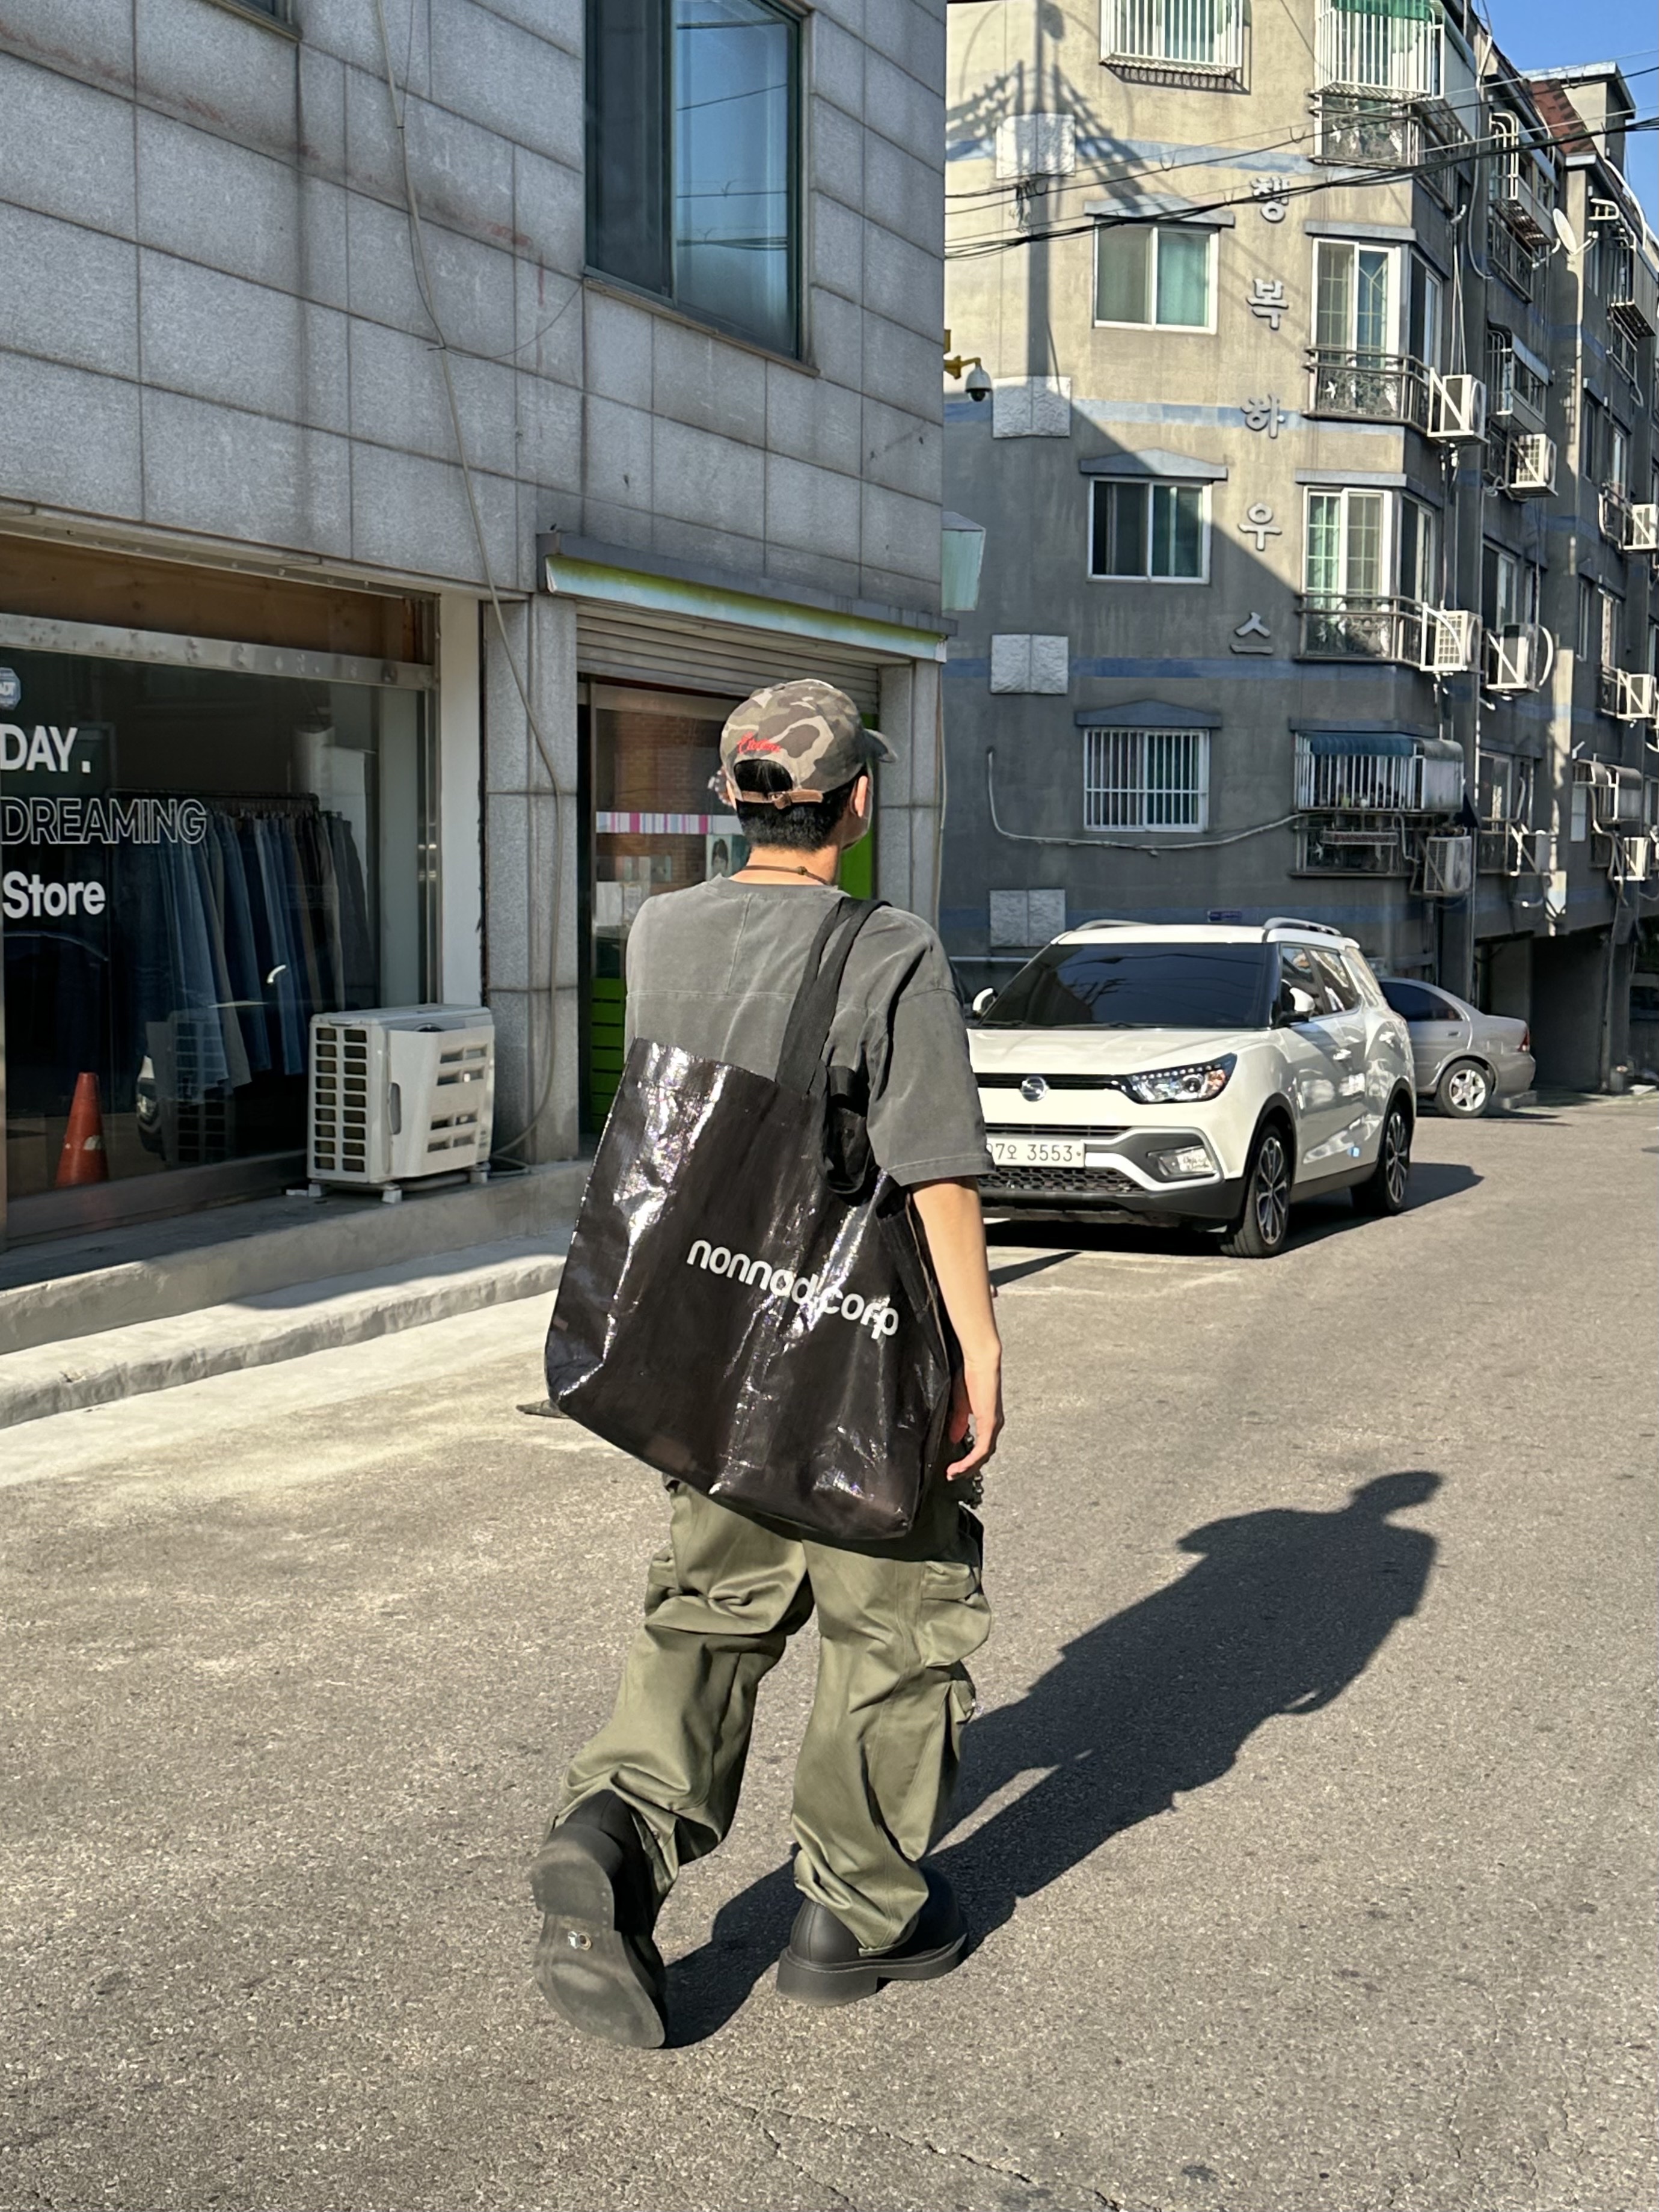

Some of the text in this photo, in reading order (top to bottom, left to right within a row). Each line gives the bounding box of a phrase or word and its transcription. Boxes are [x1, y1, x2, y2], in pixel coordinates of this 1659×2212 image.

[0, 723, 91, 773] DAY.
[0, 796, 207, 845] DREAMING
[2, 871, 106, 919] Store
[1027, 1144, 1073, 1162] 3553
